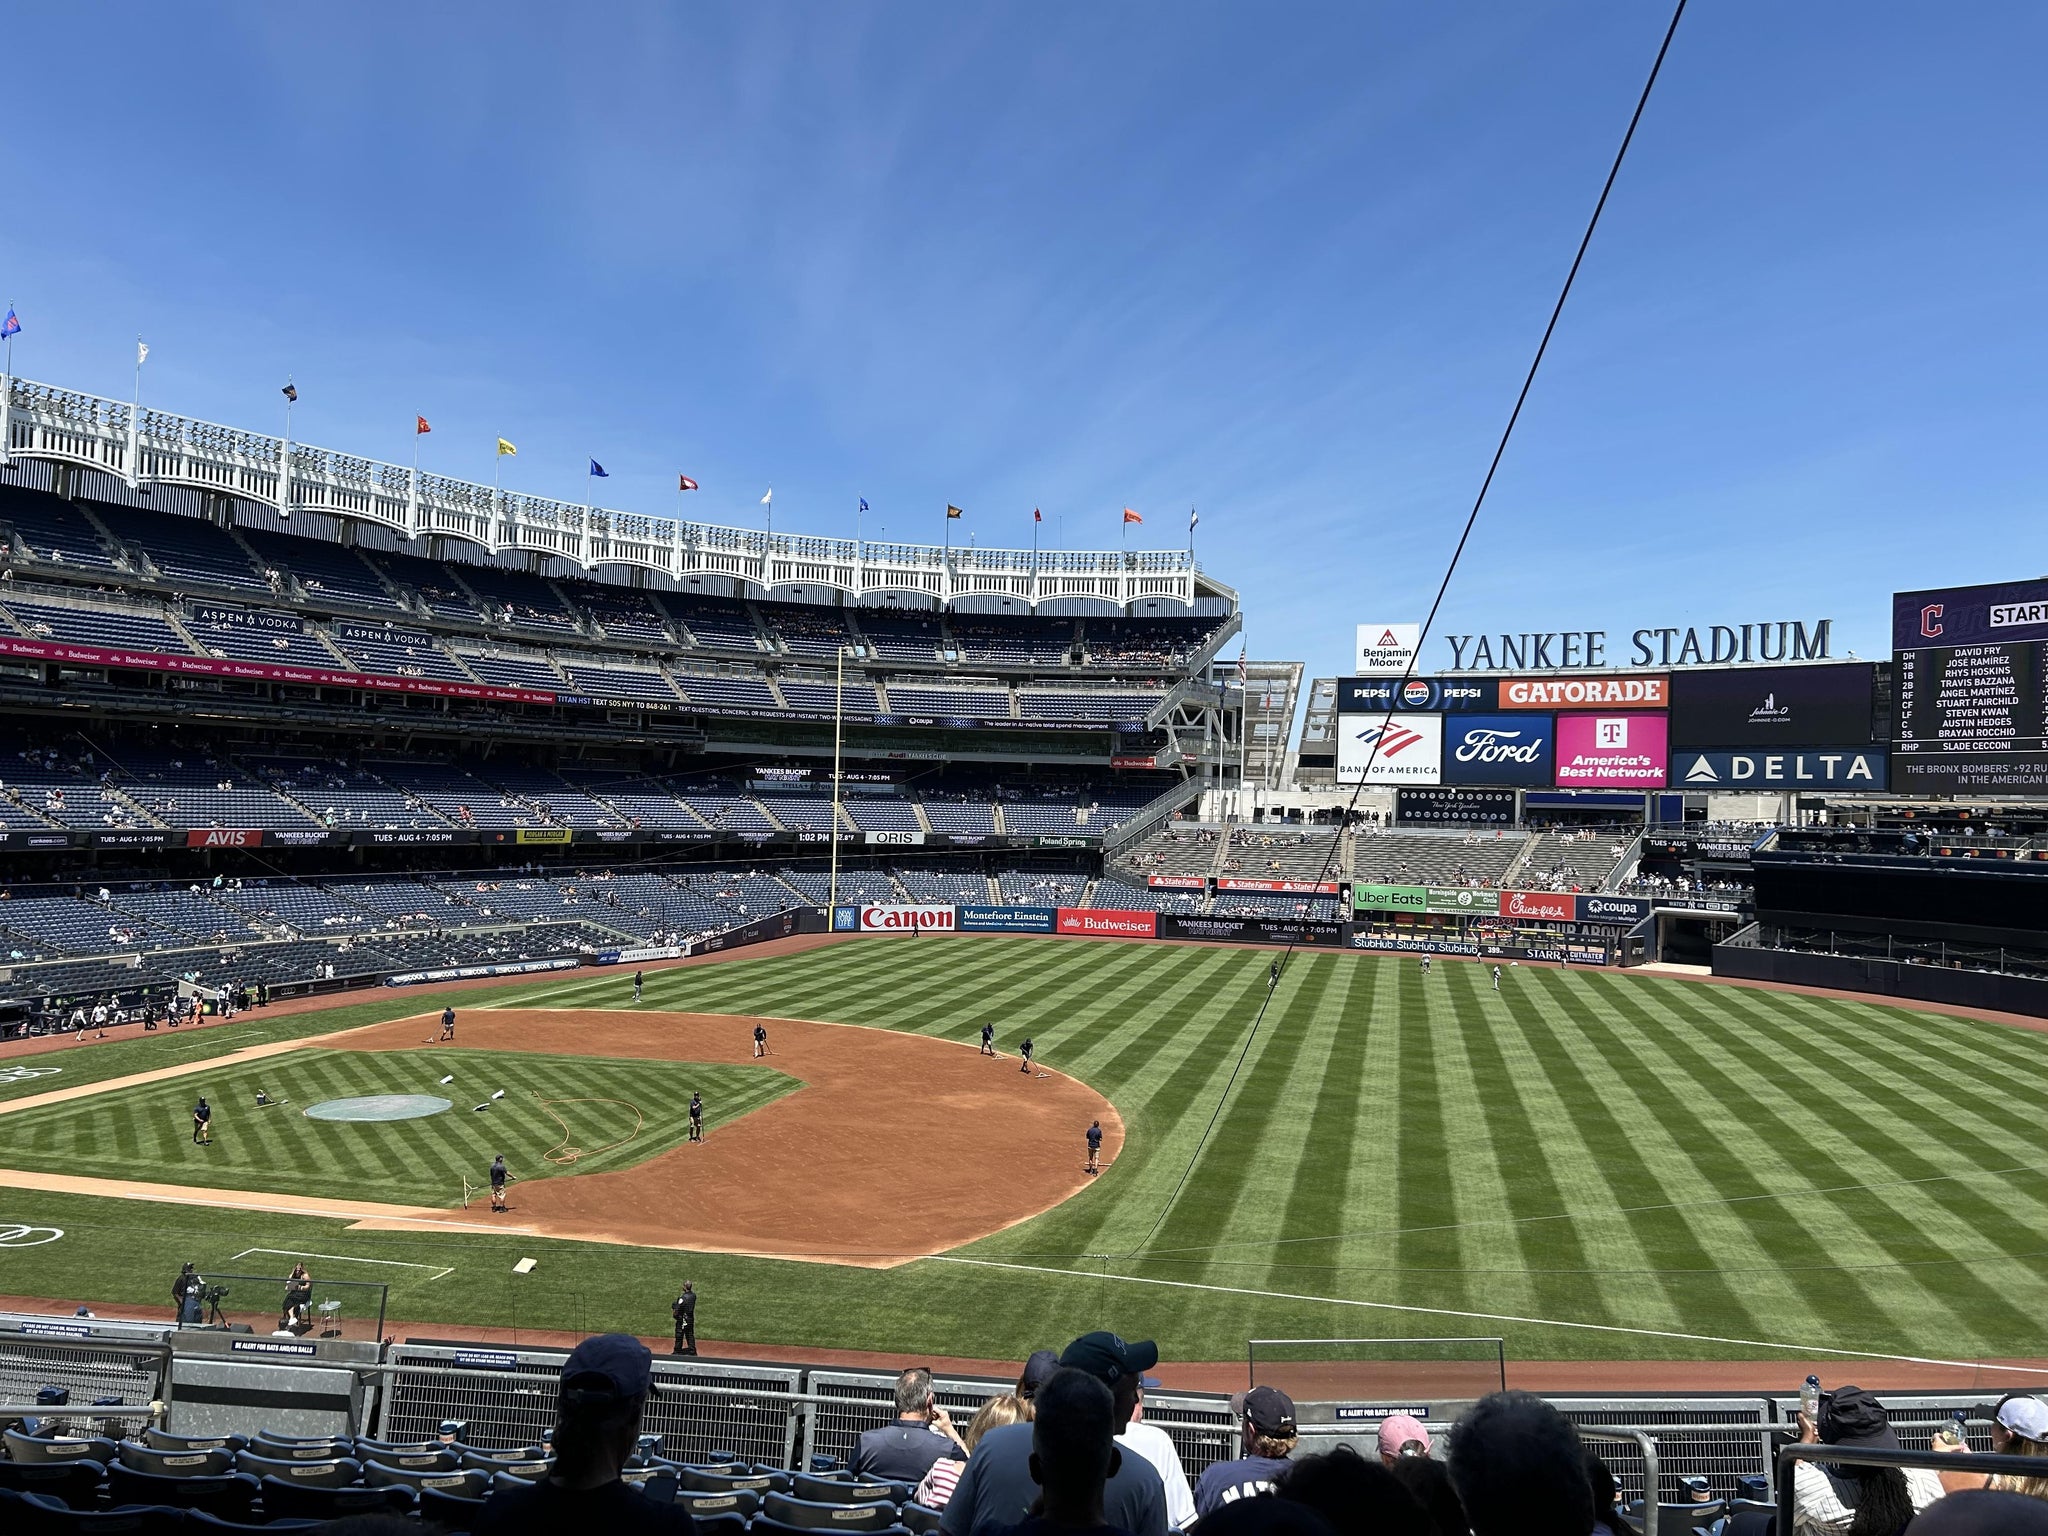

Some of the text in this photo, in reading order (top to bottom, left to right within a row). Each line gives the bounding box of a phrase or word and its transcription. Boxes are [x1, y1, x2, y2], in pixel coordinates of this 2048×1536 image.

[201, 610, 298, 630] ASPEN VODKA
[1921, 604, 1944, 638] C
[346, 628, 428, 646] ASPEN VODKA
[12, 644, 45, 656] Budweiser
[1445, 619, 1833, 670] YANKEE STADIUM
[68, 650, 100, 662] Budweiser
[1363, 648, 1412, 660] Benjamin
[1903, 647, 2001, 660] DH DAVID FRY
[125, 656, 158, 666] Budweiser
[182, 660, 213, 671] Budweiser
[1369, 658, 1403, 667] Moore
[1946, 658, 1968, 667] JOSÉ
[1971, 656, 2009, 666] RAMÍREZ
[235, 666, 264, 676] Budweiser
[285, 671, 312, 680] Budweiser
[1945, 669, 1968, 677] RHYS
[1971, 667, 2010, 676] HOSKINS
[332, 676, 358, 684] Budweiser
[376, 680, 401, 688] Budweiser
[1941, 679, 1972, 688] TRAVIS
[1975, 677, 2015, 686] BAZZANA
[418, 684, 442, 692] Budweiser
[1354, 688, 1390, 699] PEPSI
[1444, 688, 1481, 698] PEPSI
[1508, 680, 1661, 704] GATORADE
[1940, 689, 1968, 698] ANGEL
[1971, 686, 2015, 696] MARTÍNEZ
[557, 695, 577, 704] TITAN
[578, 697, 591, 705] HST
[592, 698, 608, 706] TEXT
[609, 699, 621, 707] SOS
[622, 700, 635, 708] NYY
[646, 702, 671, 711] 848-261
[1936, 699, 1970, 708] STUART
[1973, 697, 2019, 706] FAIRCHILD
[1946, 709, 1979, 717] STEVEN
[1981, 708, 2008, 716] KWAN
[1942, 719, 1974, 727] AUSTIN
[1977, 718, 2011, 726] HEDGES
[1939, 729, 1974, 738] BRAYAN
[1976, 728, 2015, 736] ROCCHIO
[1455, 729, 1542, 764] Ford
[1972, 742, 2010, 750] CECCONI
[1124, 759, 1153, 768] Budweiser
[1571, 755, 1651, 766] America's
[1388, 766, 1438, 774] AMERICA
[1559, 766, 1664, 779] Best Network
[1732, 755, 1873, 780] DELTA
[1906, 765, 1924, 773] THE
[1927, 765, 1959, 773] BRONX
[1962, 765, 2010, 773] BOMBERS'
[2013, 764, 2031, 773] +92
[1958, 775, 2042, 784] IN THE AMERICAN
[1444, 801, 1457, 809] York
[205, 832, 246, 846] AVIS
[817, 834, 830, 842] PM
[876, 833, 913, 844] ORIS
[1040, 837, 1086, 847] Poland Spring
[1358, 891, 1423, 905] Uber Eats
[1604, 902, 1637, 915] coupa
[863, 908, 952, 928] Canon
[964, 911, 1048, 921] Montefiore Einstein
[1083, 917, 1151, 932] Budweiser
[1177, 920, 1244, 930] YANKEES BUCKET
[1206, 928, 1232, 936] NIGHT
[1354, 938, 1393, 949] StubHub
[1397, 941, 1435, 951] StubHub
[1439, 943, 1478, 954] StubHub
[1526, 949, 1561, 960] STARR
[1570, 951, 1604, 960] CUTWATER
